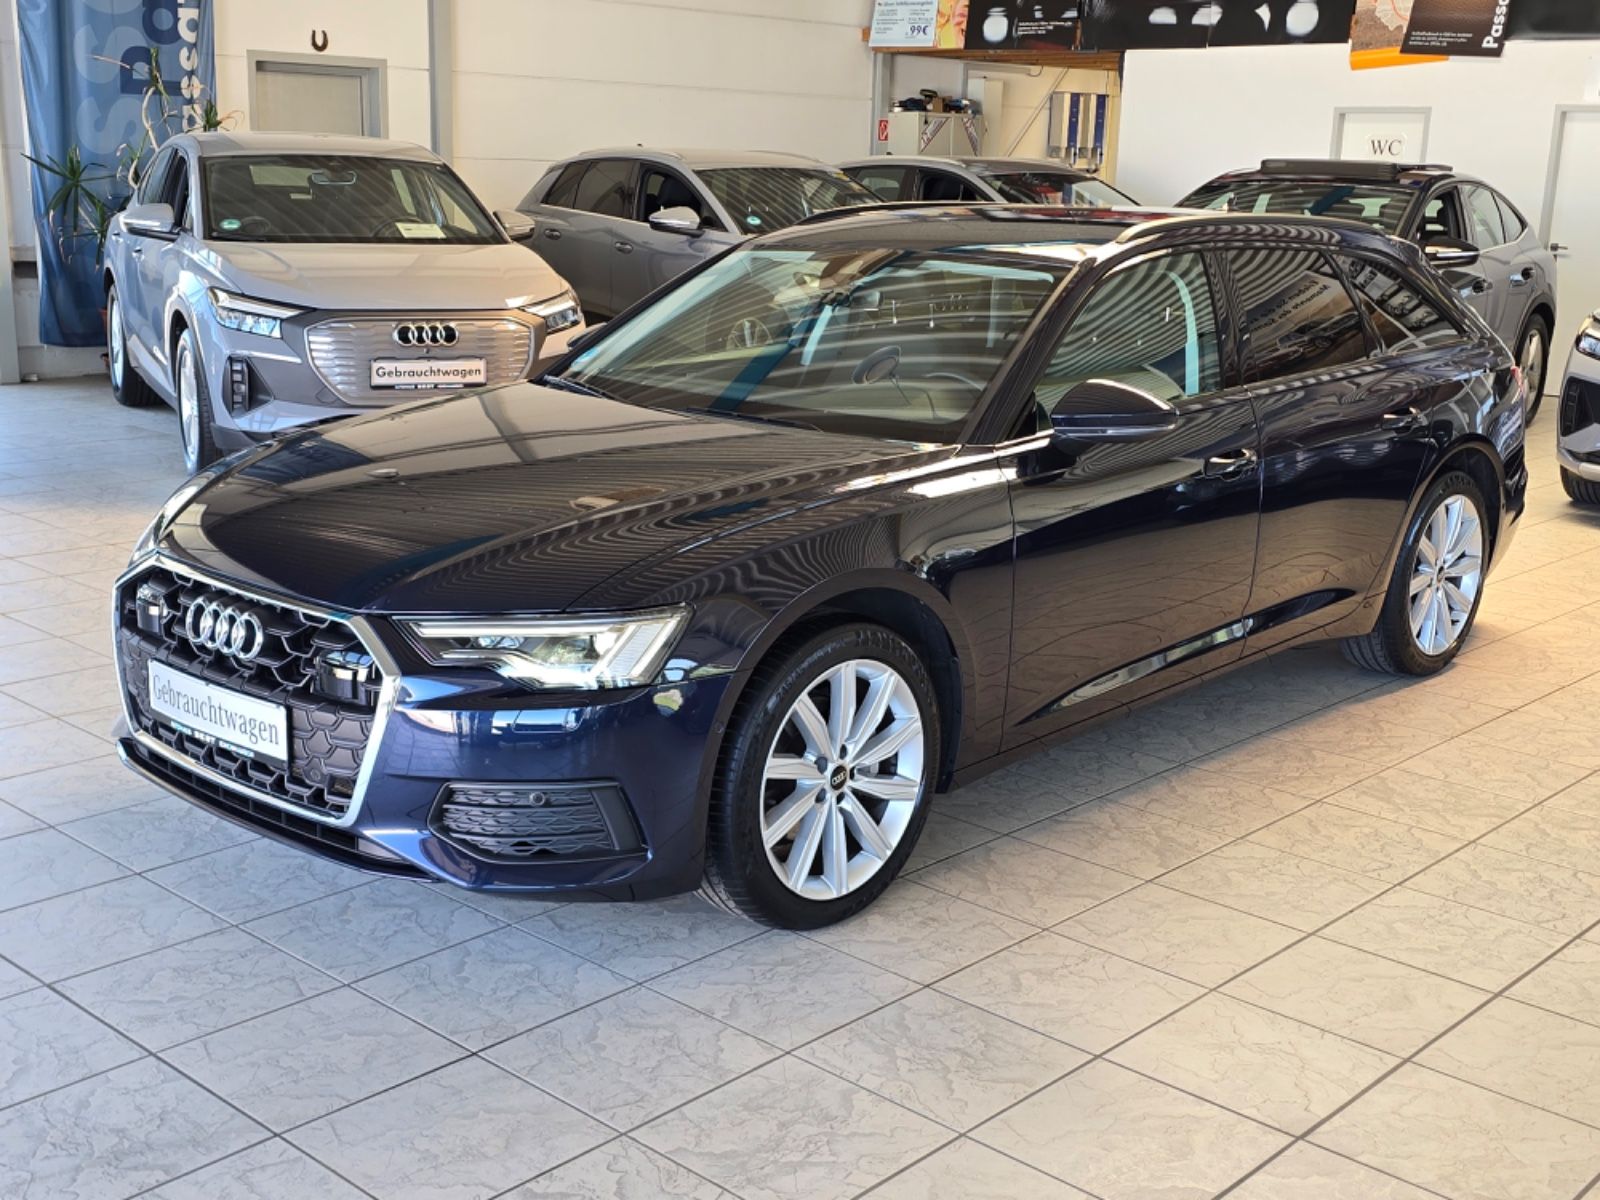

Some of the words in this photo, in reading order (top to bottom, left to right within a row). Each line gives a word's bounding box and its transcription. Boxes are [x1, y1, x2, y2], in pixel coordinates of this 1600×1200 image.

[1371, 139, 1401, 156] WC
[375, 366, 481, 379] Gebrauchtwagen
[152, 674, 280, 745] Gebrauchtwagen
